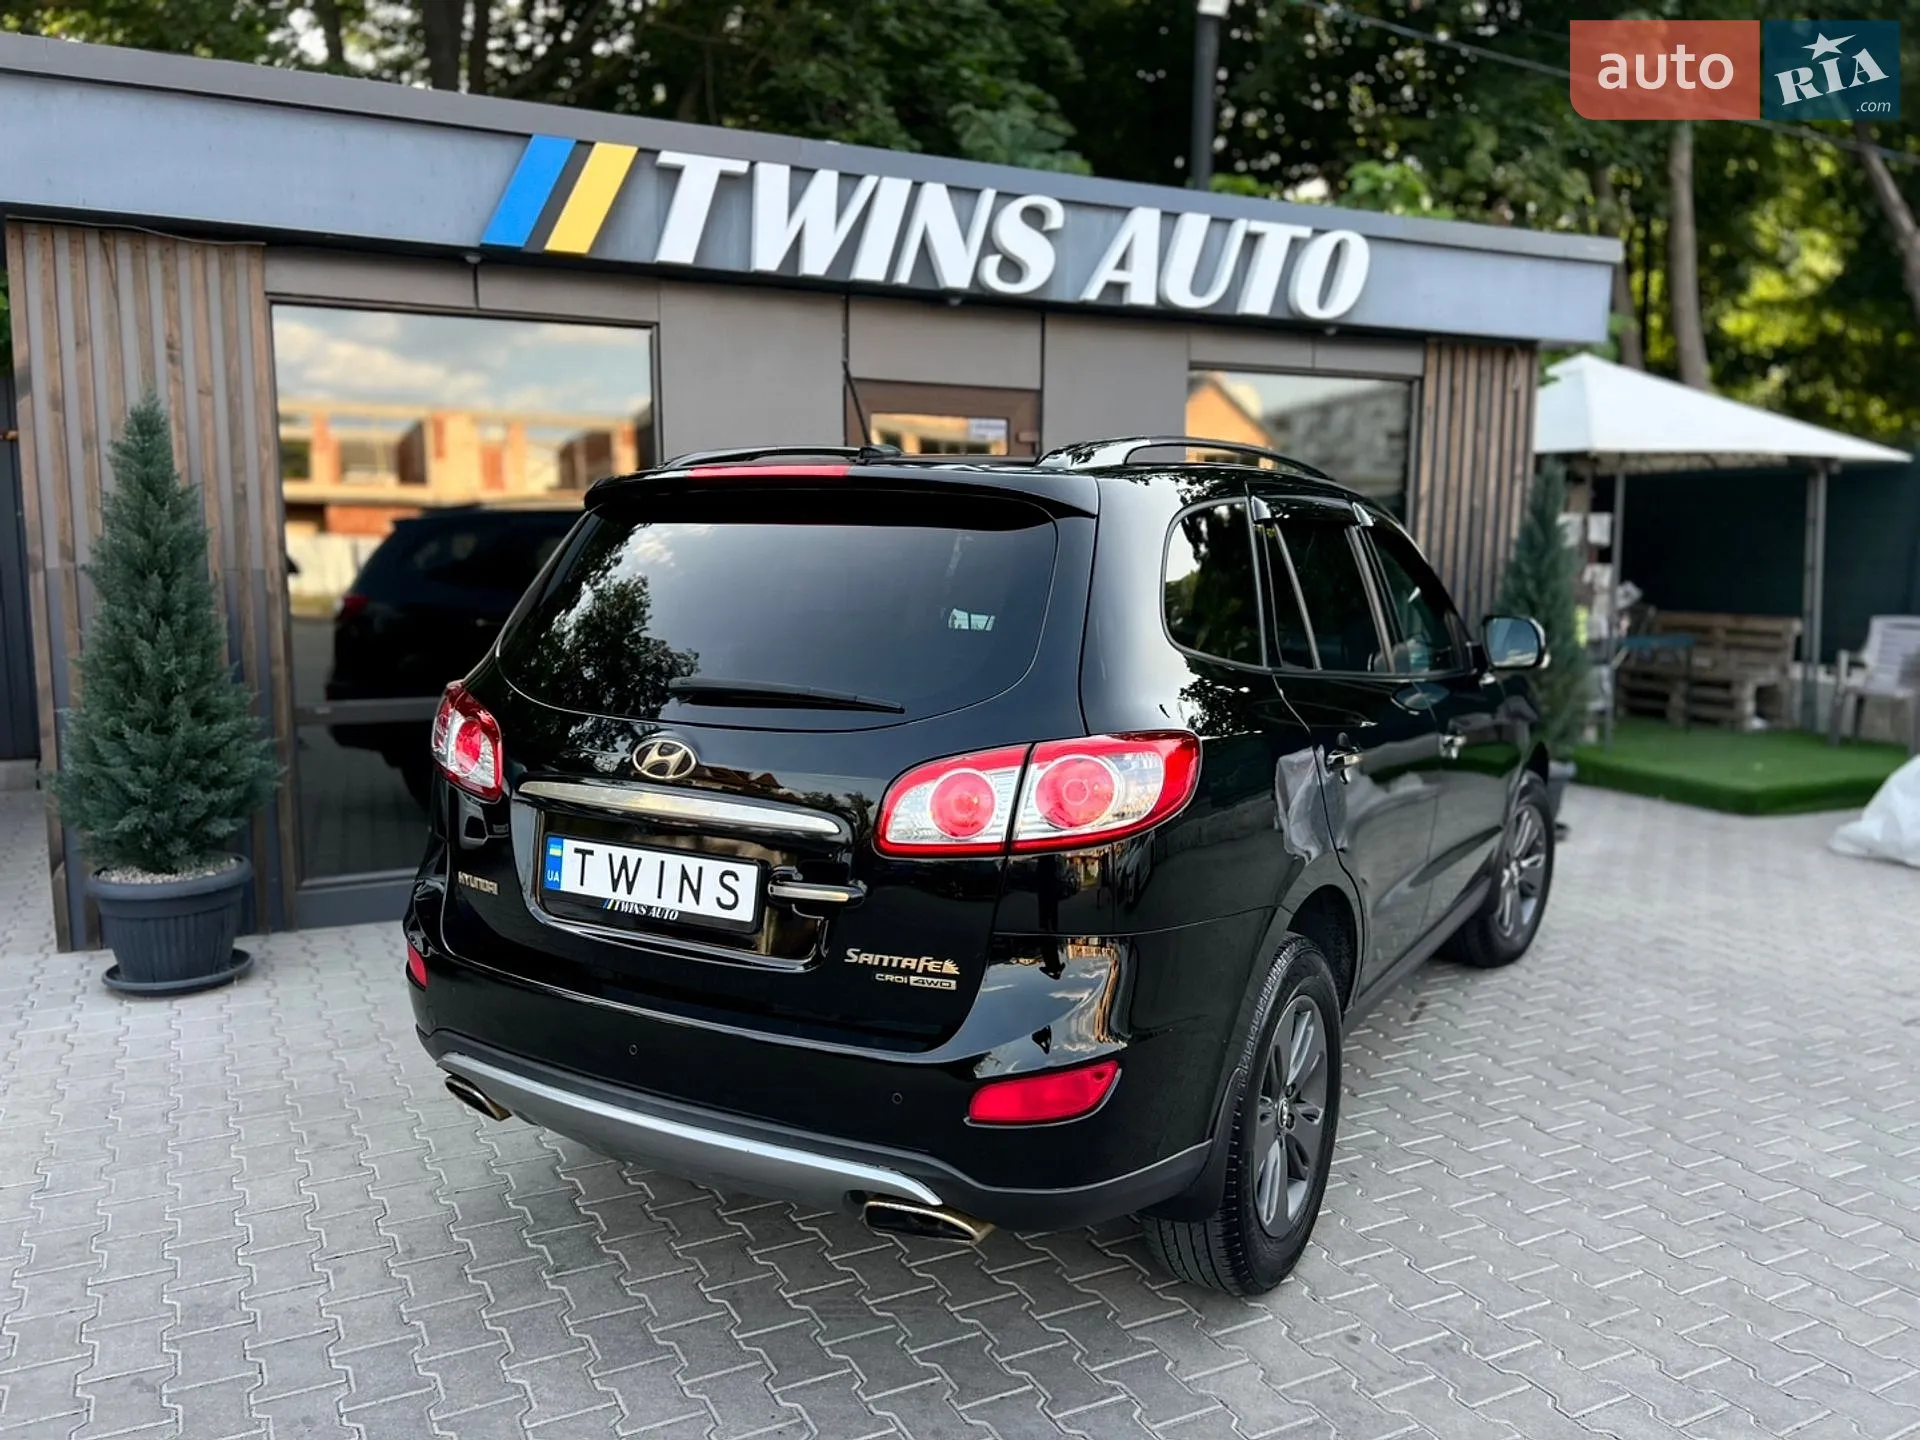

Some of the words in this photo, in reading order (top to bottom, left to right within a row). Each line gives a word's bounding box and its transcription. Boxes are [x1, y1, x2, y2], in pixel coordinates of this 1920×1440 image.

[654, 150, 1065, 295] TWINS
[1080, 206, 1371, 321] AUTO
[547, 869, 560, 883] UA
[573, 847, 741, 912] TWINS
[612, 900, 648, 915] TWINS
[648, 906, 679, 920] AUTO
[912, 977, 953, 989] 4WD
